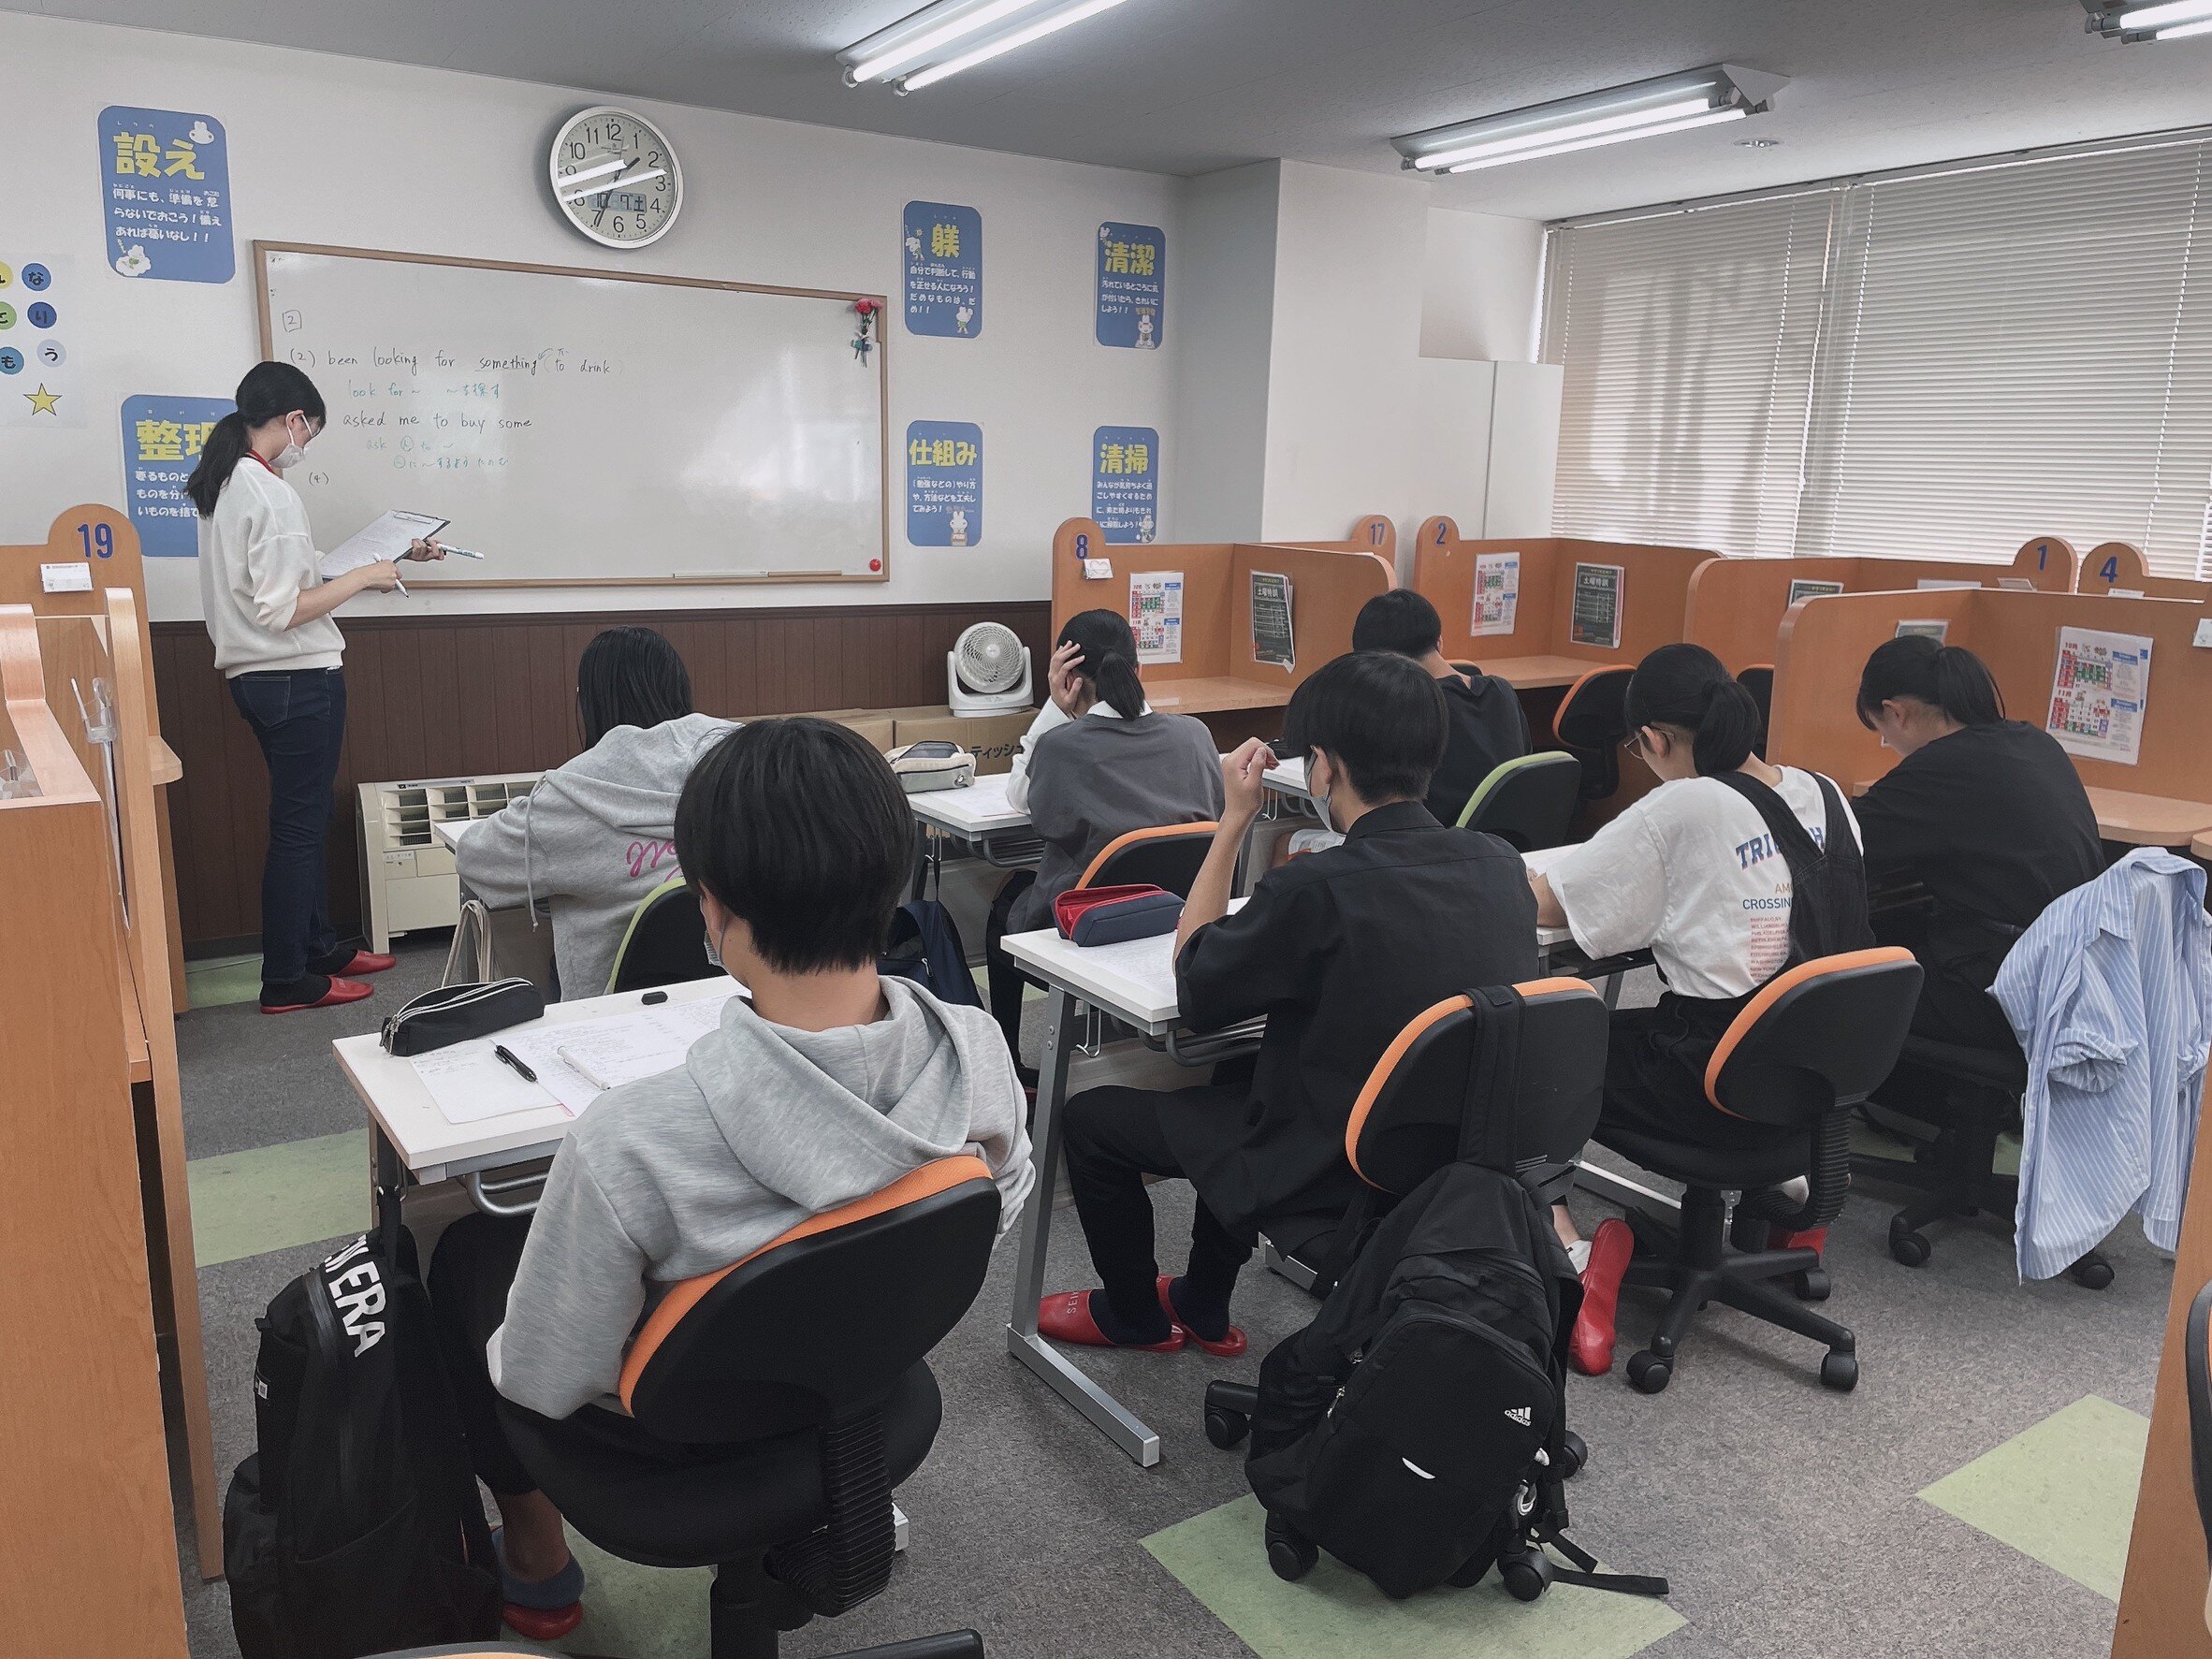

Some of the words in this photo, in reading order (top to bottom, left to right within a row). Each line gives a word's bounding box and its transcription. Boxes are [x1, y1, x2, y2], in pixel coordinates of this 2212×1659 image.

[586, 126, 599, 145] 11
[605, 123, 622, 141] 12
[633, 132, 639, 150] 1
[112, 131, 205, 181] 設え
[569, 141, 586, 160] 10
[648, 151, 660, 168] 2
[655, 175, 666, 192] 3
[649, 197, 662, 214] 4
[591, 209, 603, 226] 7
[613, 215, 625, 233] 6
[635, 213, 647, 230] 5
[1104, 240, 1156, 276] 清潔
[28, 271, 45, 286] な
[327, 350, 358, 365] been
[373, 346, 418, 376] looking
[434, 349, 457, 368] for
[478, 355, 538, 376] something
[348, 380, 377, 399] look
[387, 382, 404, 398] for
[342, 410, 386, 429] asked
[399, 415, 420, 425] me
[433, 412, 449, 429] to
[460, 413, 486, 434] buy
[498, 418, 532, 429] some
[909, 439, 978, 467] 仕組み
[1099, 444, 1149, 474] 清掃
[77, 523, 113, 560] 19
[1370, 522, 1386, 546] 17
[1435, 522, 1448, 546] 2
[1076, 534, 1088, 560] 8
[2037, 545, 2048, 572] 1
[2099, 556, 2118, 584] 4
[1736, 826, 1825, 870] TRIH
[1775, 883, 1794, 895] AM
[1742, 897, 1794, 910] CROSSIN
[1504, 1409, 1532, 1427] adidas
